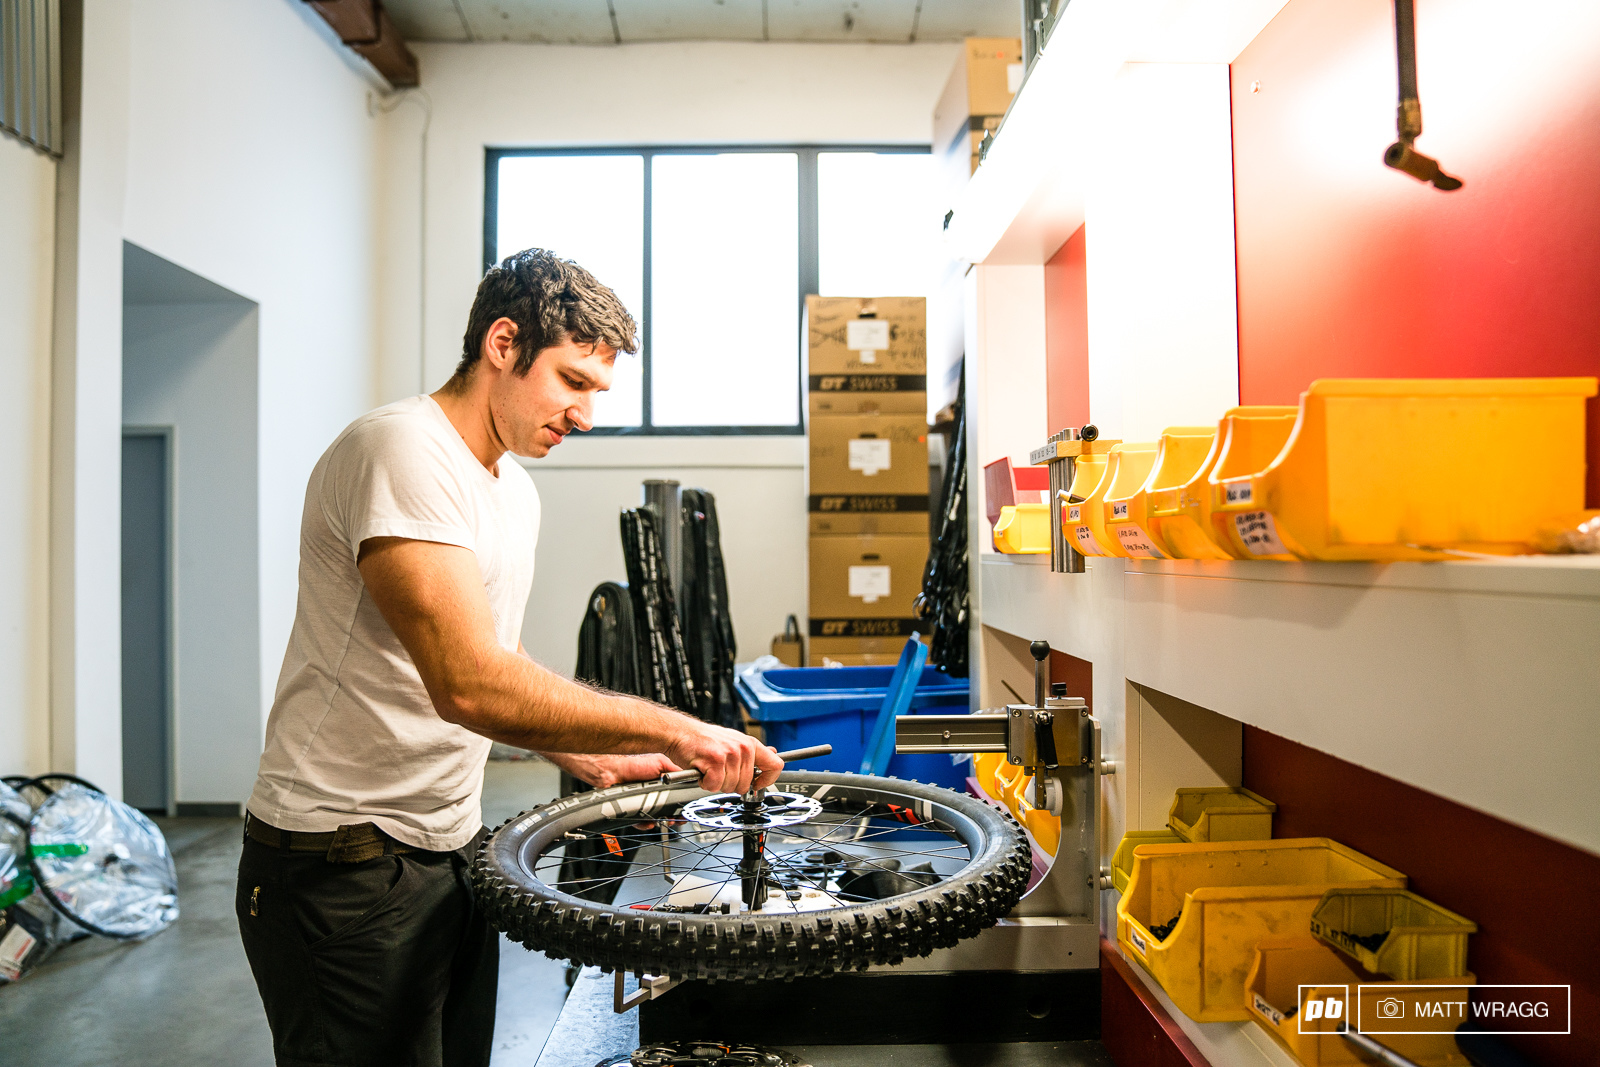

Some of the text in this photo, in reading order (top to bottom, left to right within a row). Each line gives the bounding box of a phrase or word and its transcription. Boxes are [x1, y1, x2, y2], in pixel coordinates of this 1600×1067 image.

[819, 376, 898, 391] DT SWISS
[819, 496, 898, 512] DT SWISS
[821, 620, 900, 635] DT SWISS
